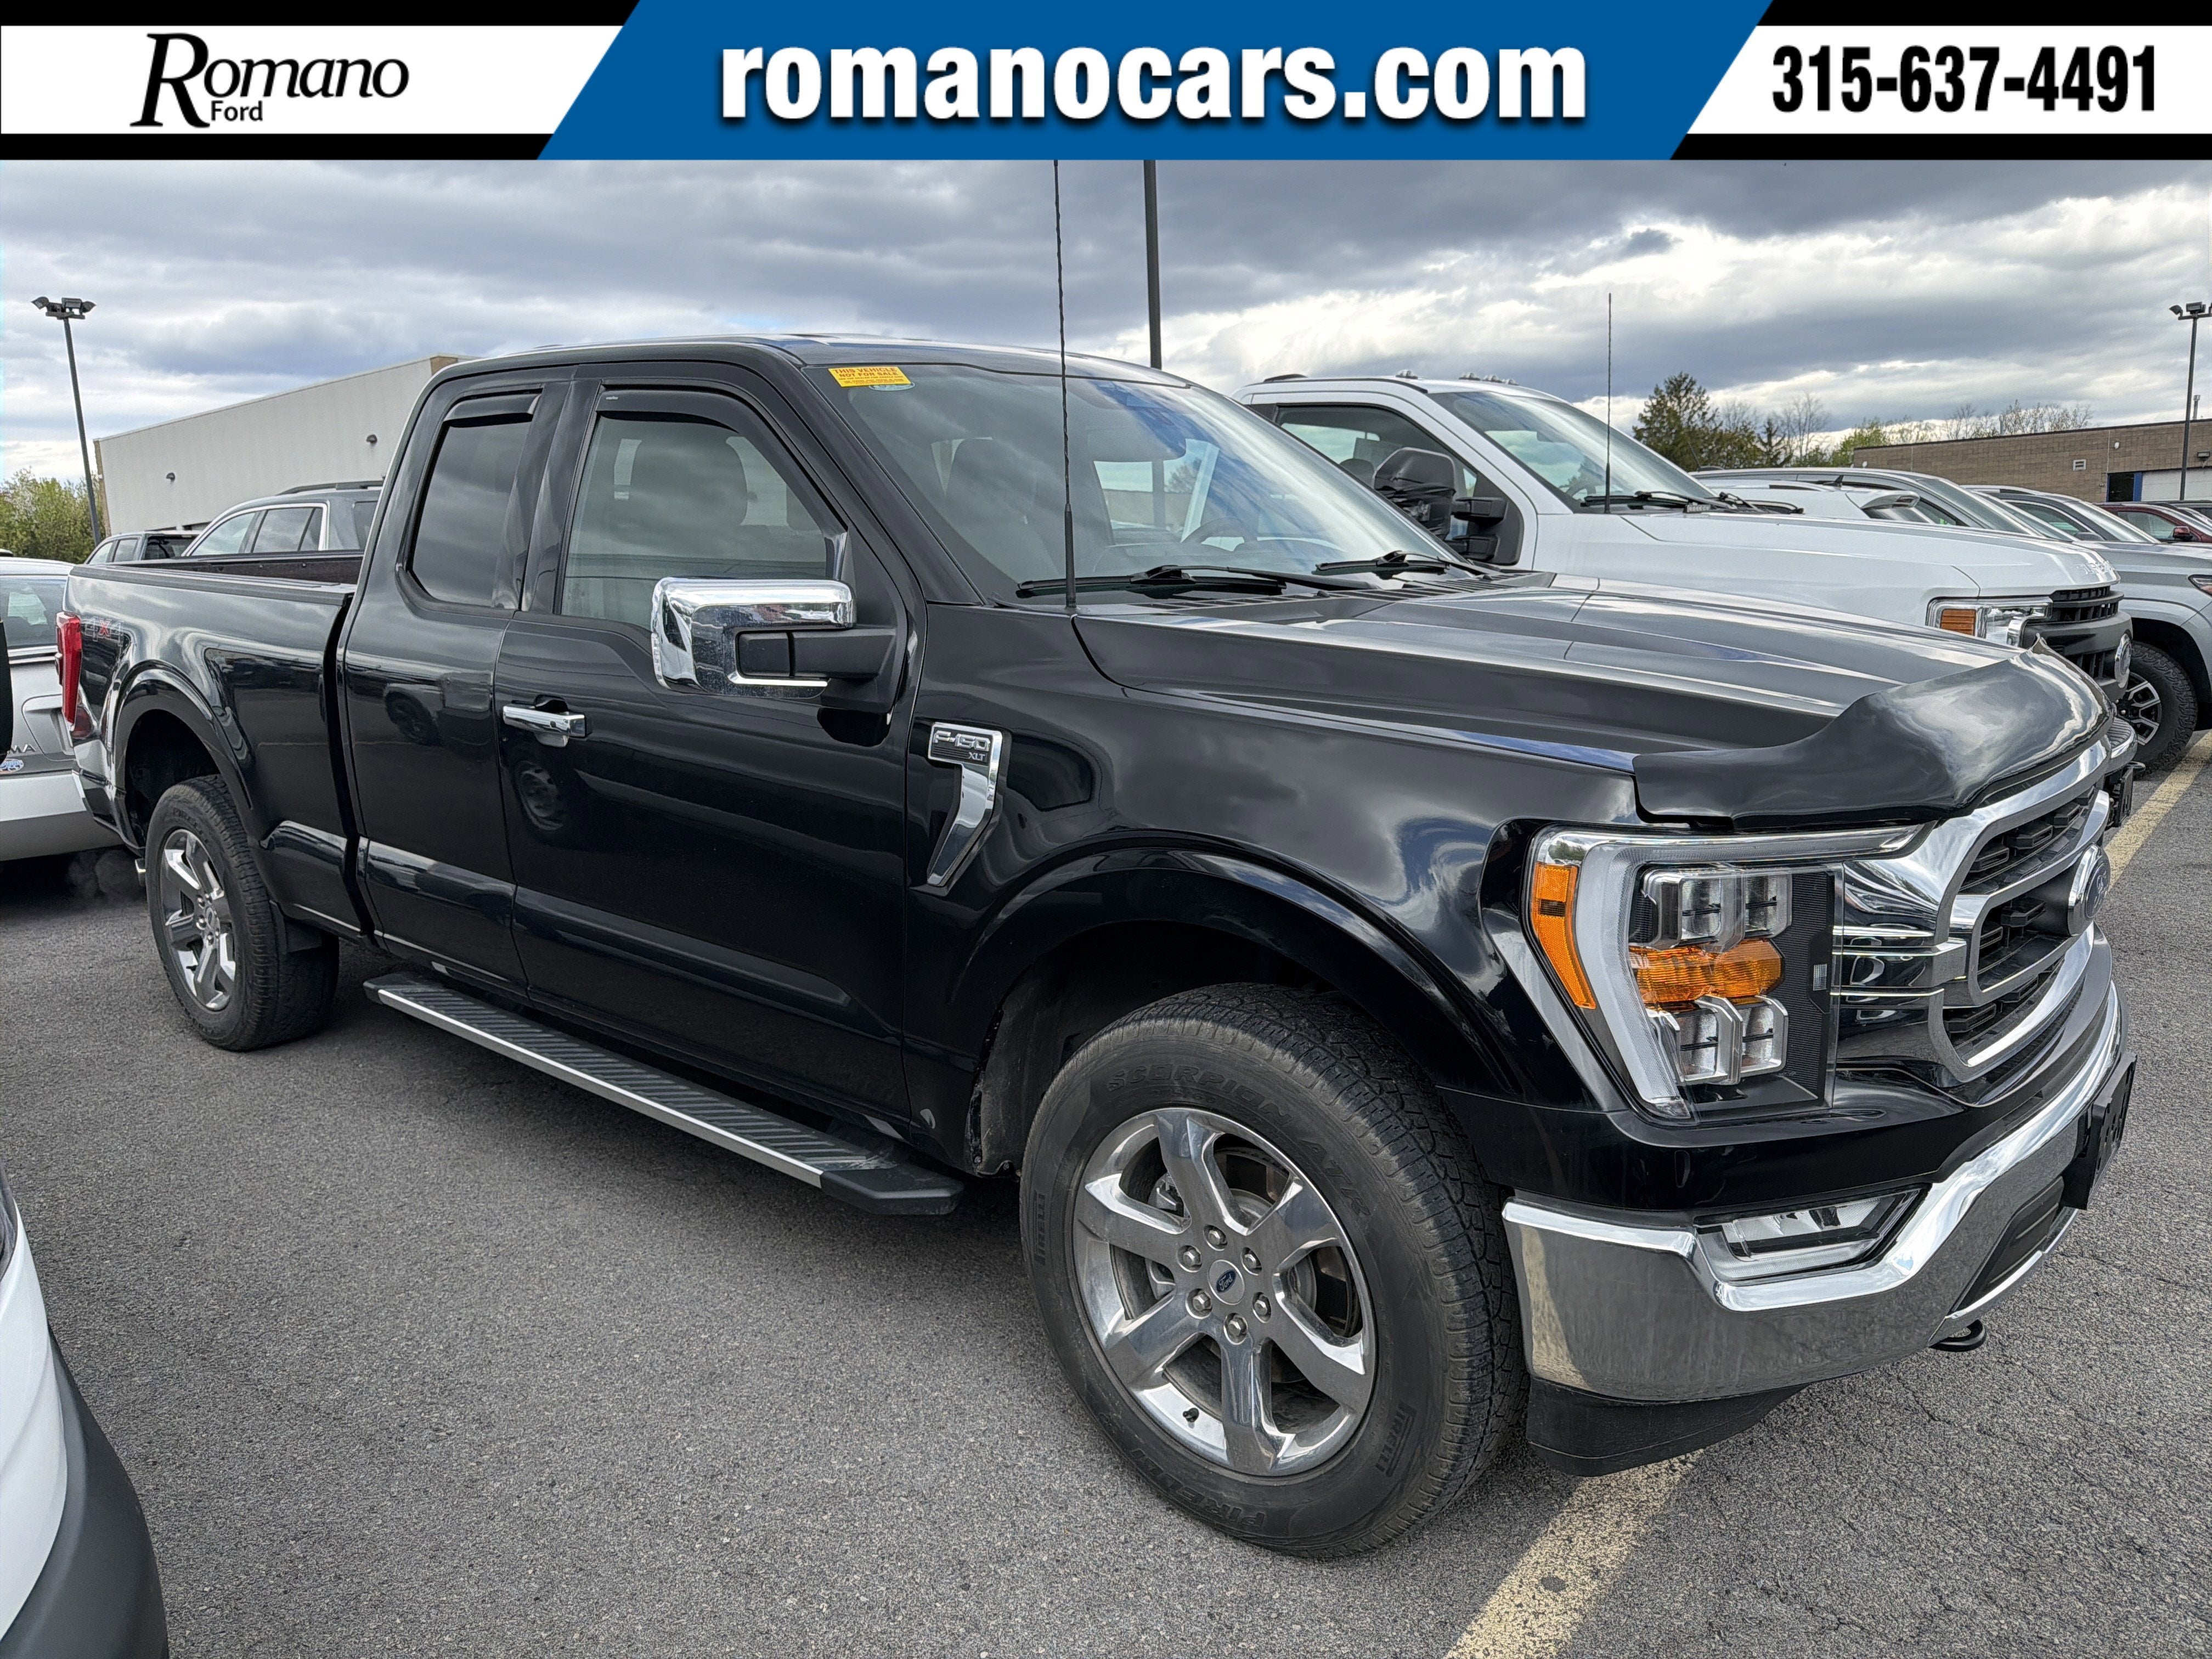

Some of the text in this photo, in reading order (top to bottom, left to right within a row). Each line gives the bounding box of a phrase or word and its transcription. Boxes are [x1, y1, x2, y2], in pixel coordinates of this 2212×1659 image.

[933, 730, 991, 752] F-150
[967, 751, 986, 762] XLT
[1107, 1063, 1294, 1126] SCORPION
[1298, 1138, 1373, 1219] ATR
[1033, 1188, 1046, 1266] PIRELLI
[1218, 1272, 1234, 1291] Ford
[1375, 1401, 1418, 1477] PIRELLI
[1130, 1448, 1266, 1528] PIRELLI
